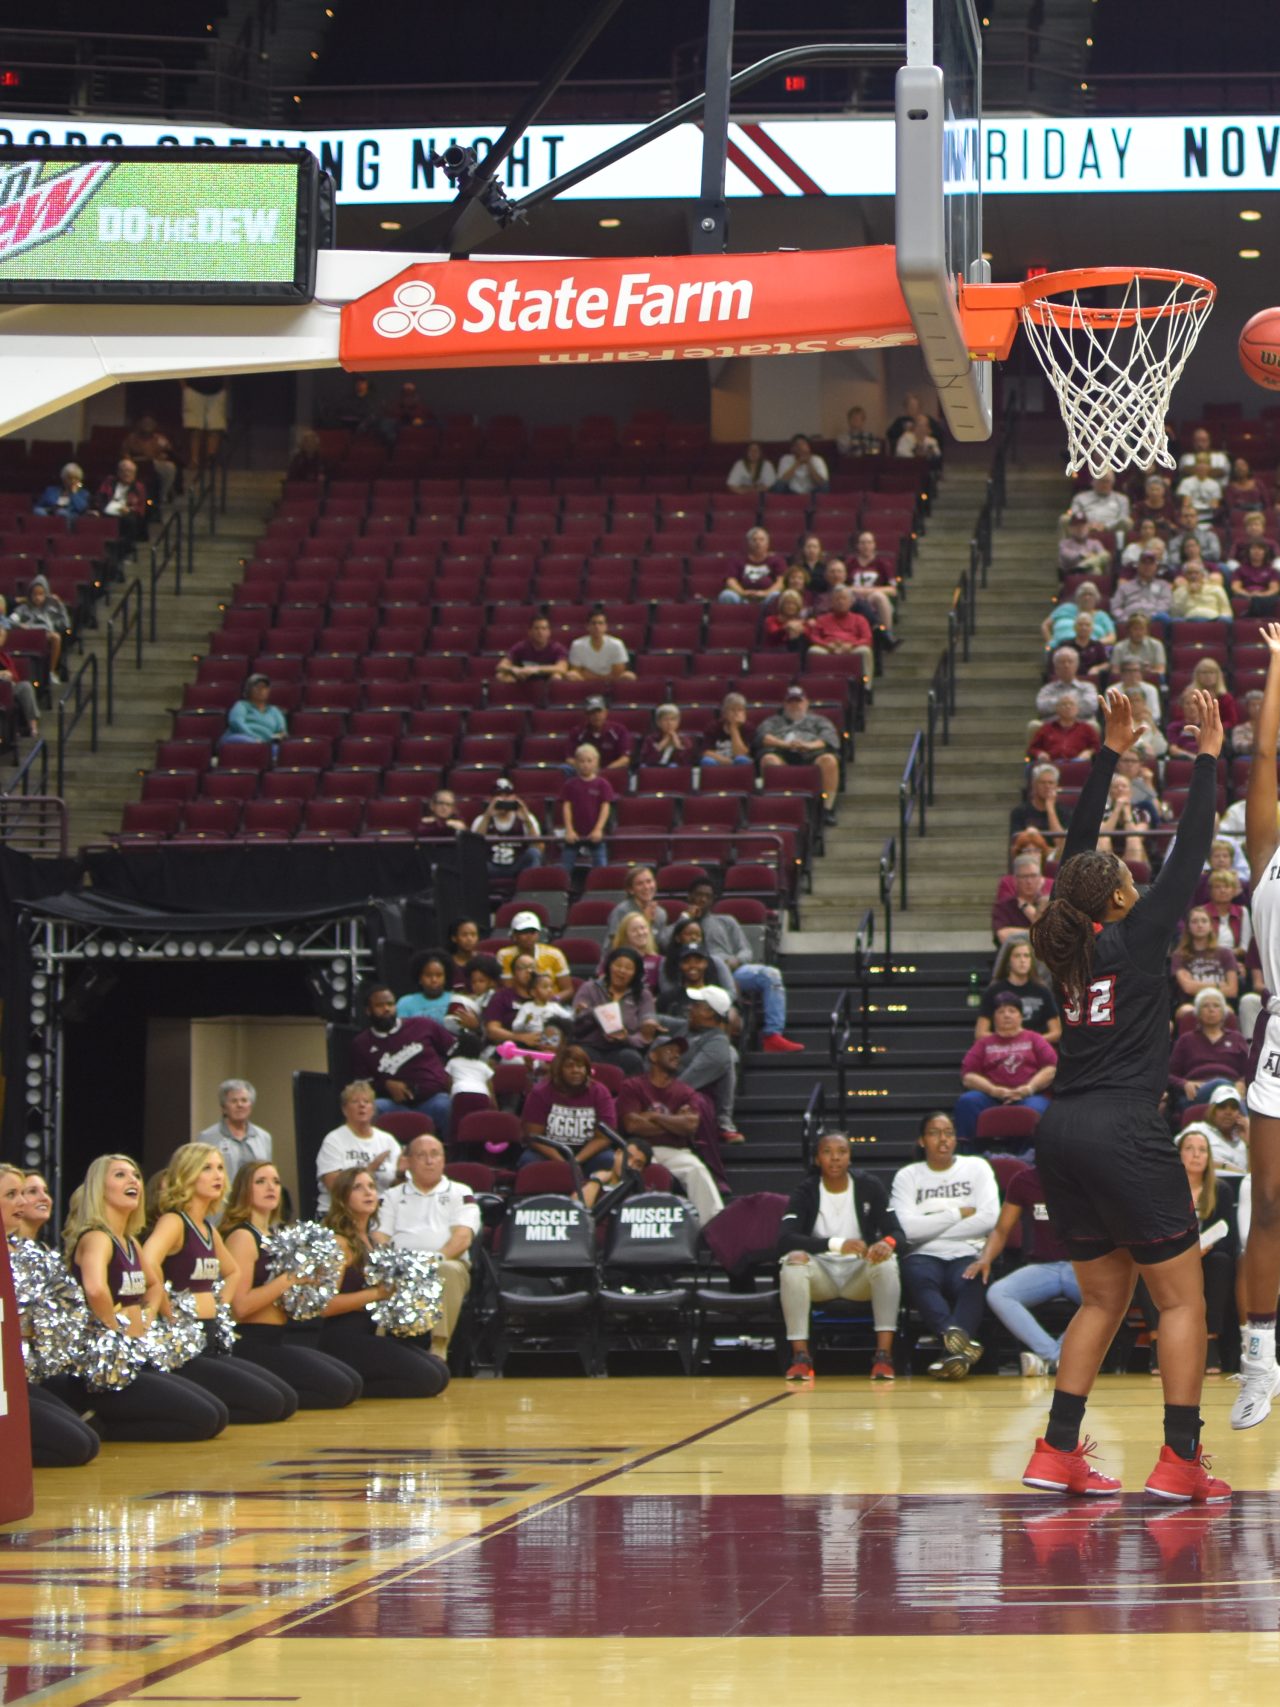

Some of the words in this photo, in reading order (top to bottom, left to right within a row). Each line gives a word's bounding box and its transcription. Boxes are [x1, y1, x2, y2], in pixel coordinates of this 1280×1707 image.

[975, 127, 1133, 180] RIDAY
[411, 136, 566, 189] NHT
[915, 1181, 973, 1206] AGGIES
[514, 1209, 580, 1226] MUSCLE
[620, 1207, 684, 1224] MUSCLE
[525, 1226, 570, 1241] MILK
[630, 1223, 674, 1239] MILK
